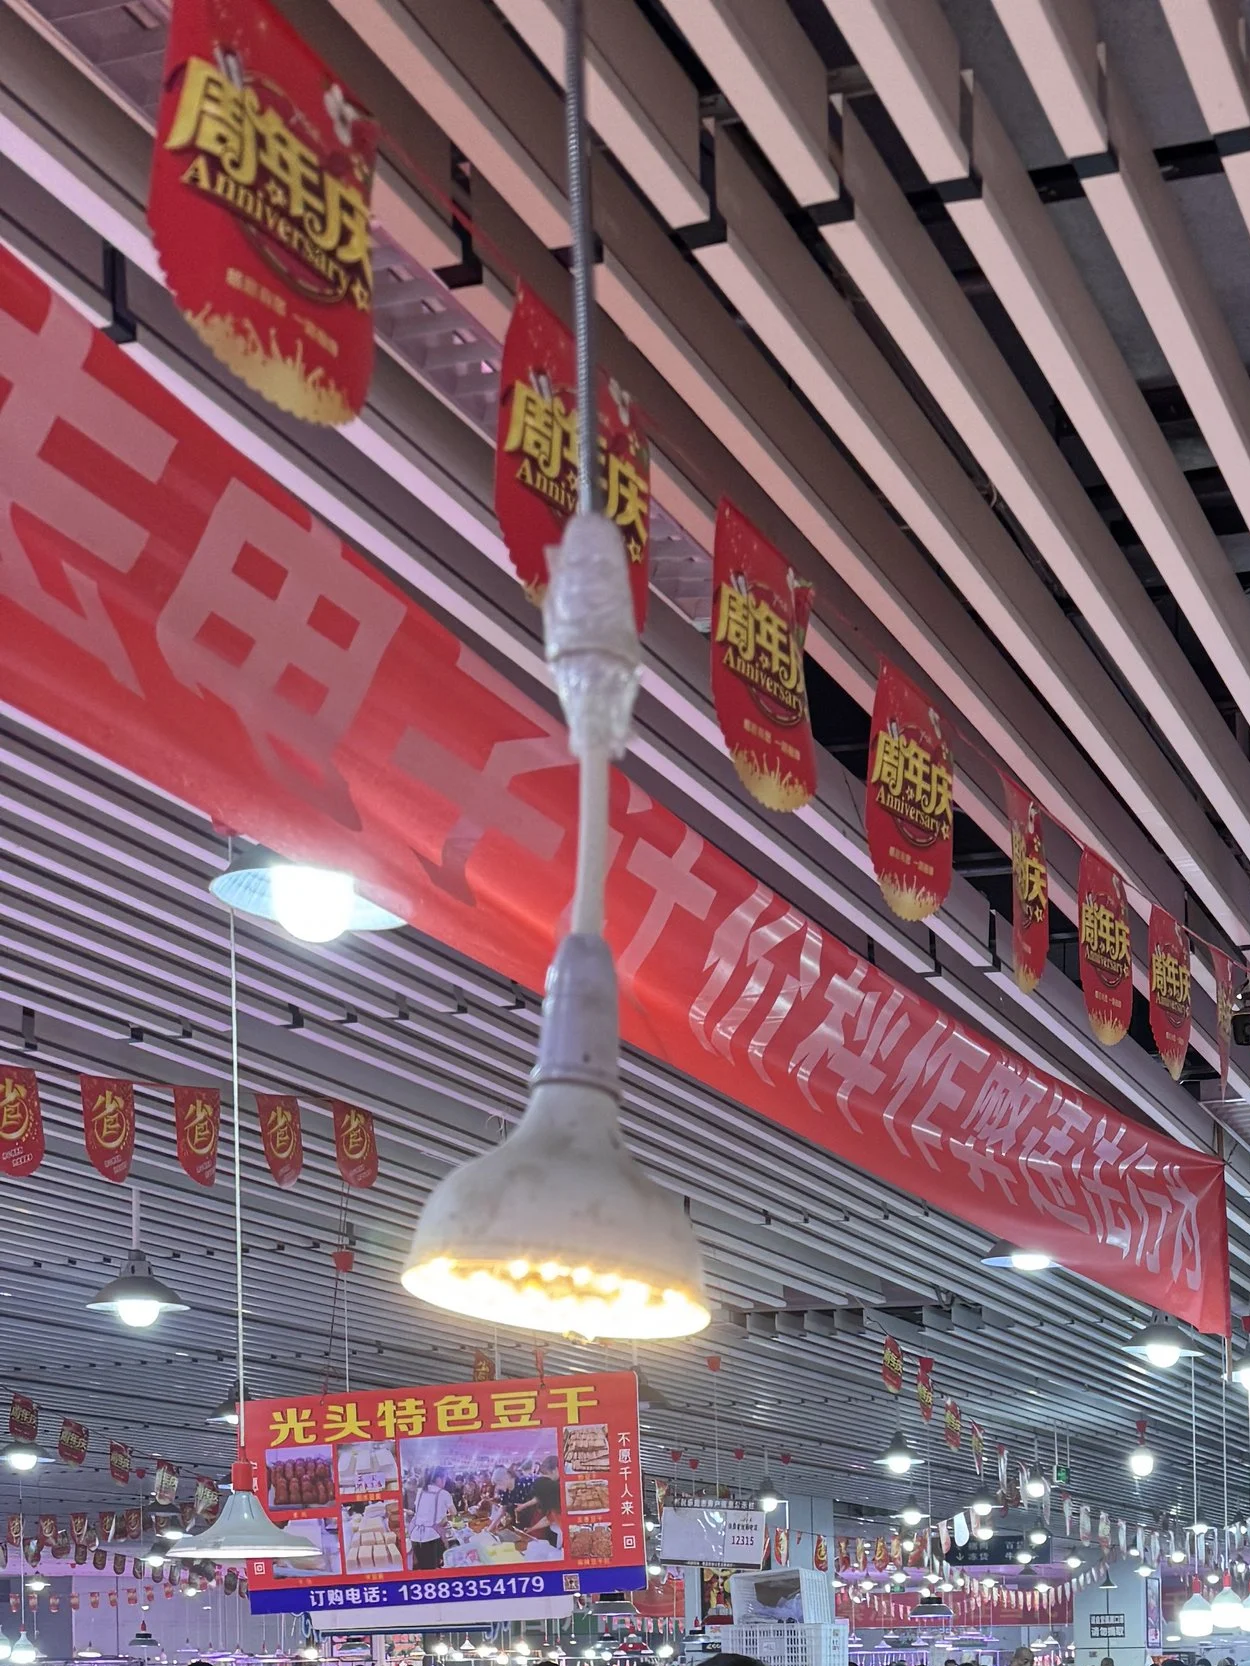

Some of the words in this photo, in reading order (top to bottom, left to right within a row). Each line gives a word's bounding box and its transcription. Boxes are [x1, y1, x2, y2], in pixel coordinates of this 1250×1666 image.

[163, 56, 374, 297] 周年庆
[180, 157, 350, 298] Anniversary
[871, 729, 954, 825] 周年庆
[875, 787, 942, 834] Anniversary
[1080, 900, 1131, 966] 周年庆
[269, 1385, 599, 1447] 光头特色豆干
[617, 1431, 637, 1550] 不愿千人来一回
[731, 1535, 754, 1546] 12315
[397, 1574, 545, 1602] 13883354179
